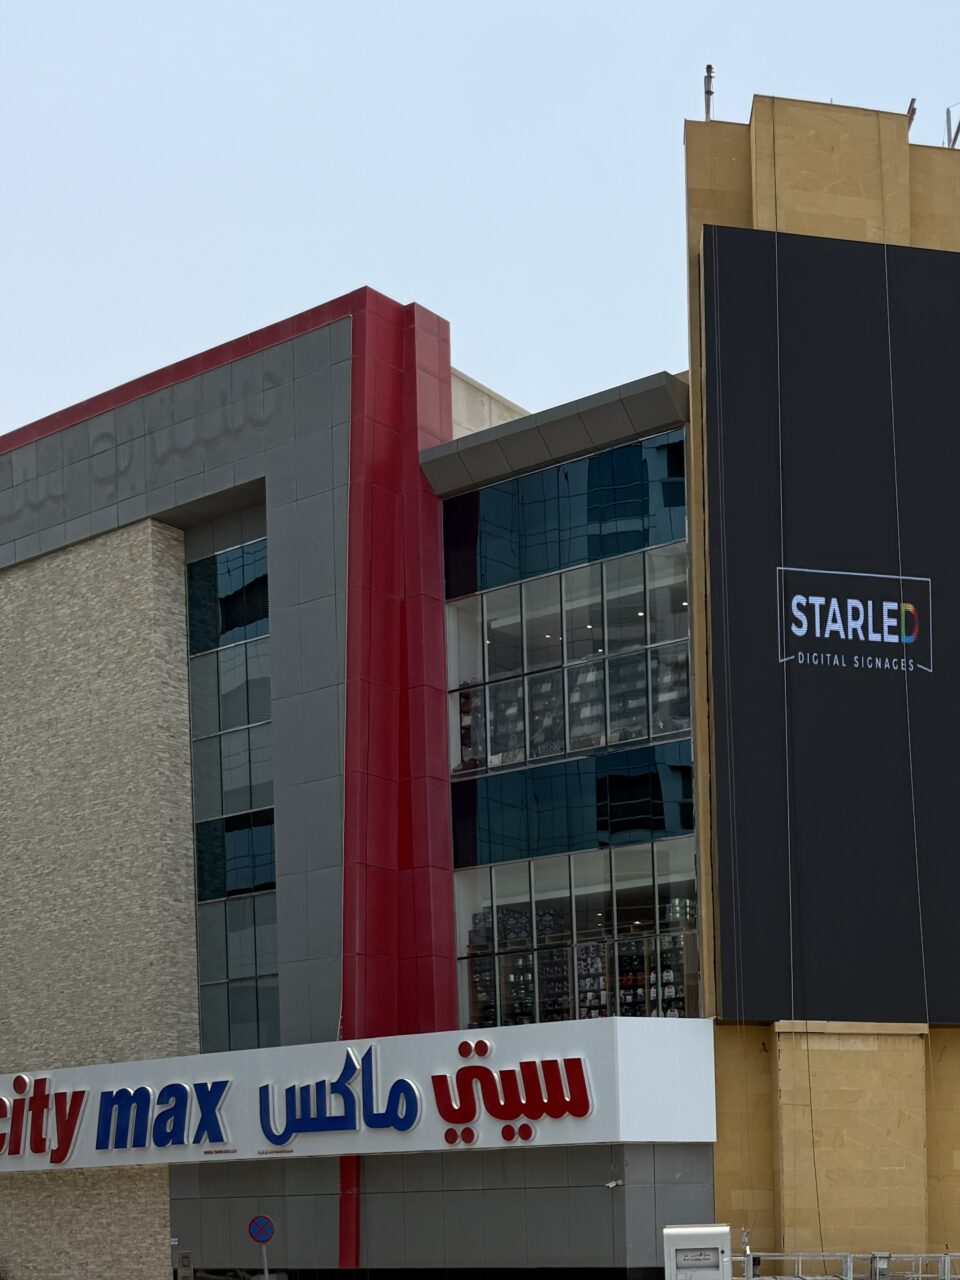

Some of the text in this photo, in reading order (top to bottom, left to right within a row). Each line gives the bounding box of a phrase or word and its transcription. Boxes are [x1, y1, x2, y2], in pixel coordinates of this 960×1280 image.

[791, 594, 918, 644] STARLED
[798, 651, 915, 672] DIGITAL SIGNAGES
[0, 1074, 230, 1163] ity max
[259, 1039, 591, 1146] سيتي ماكس
